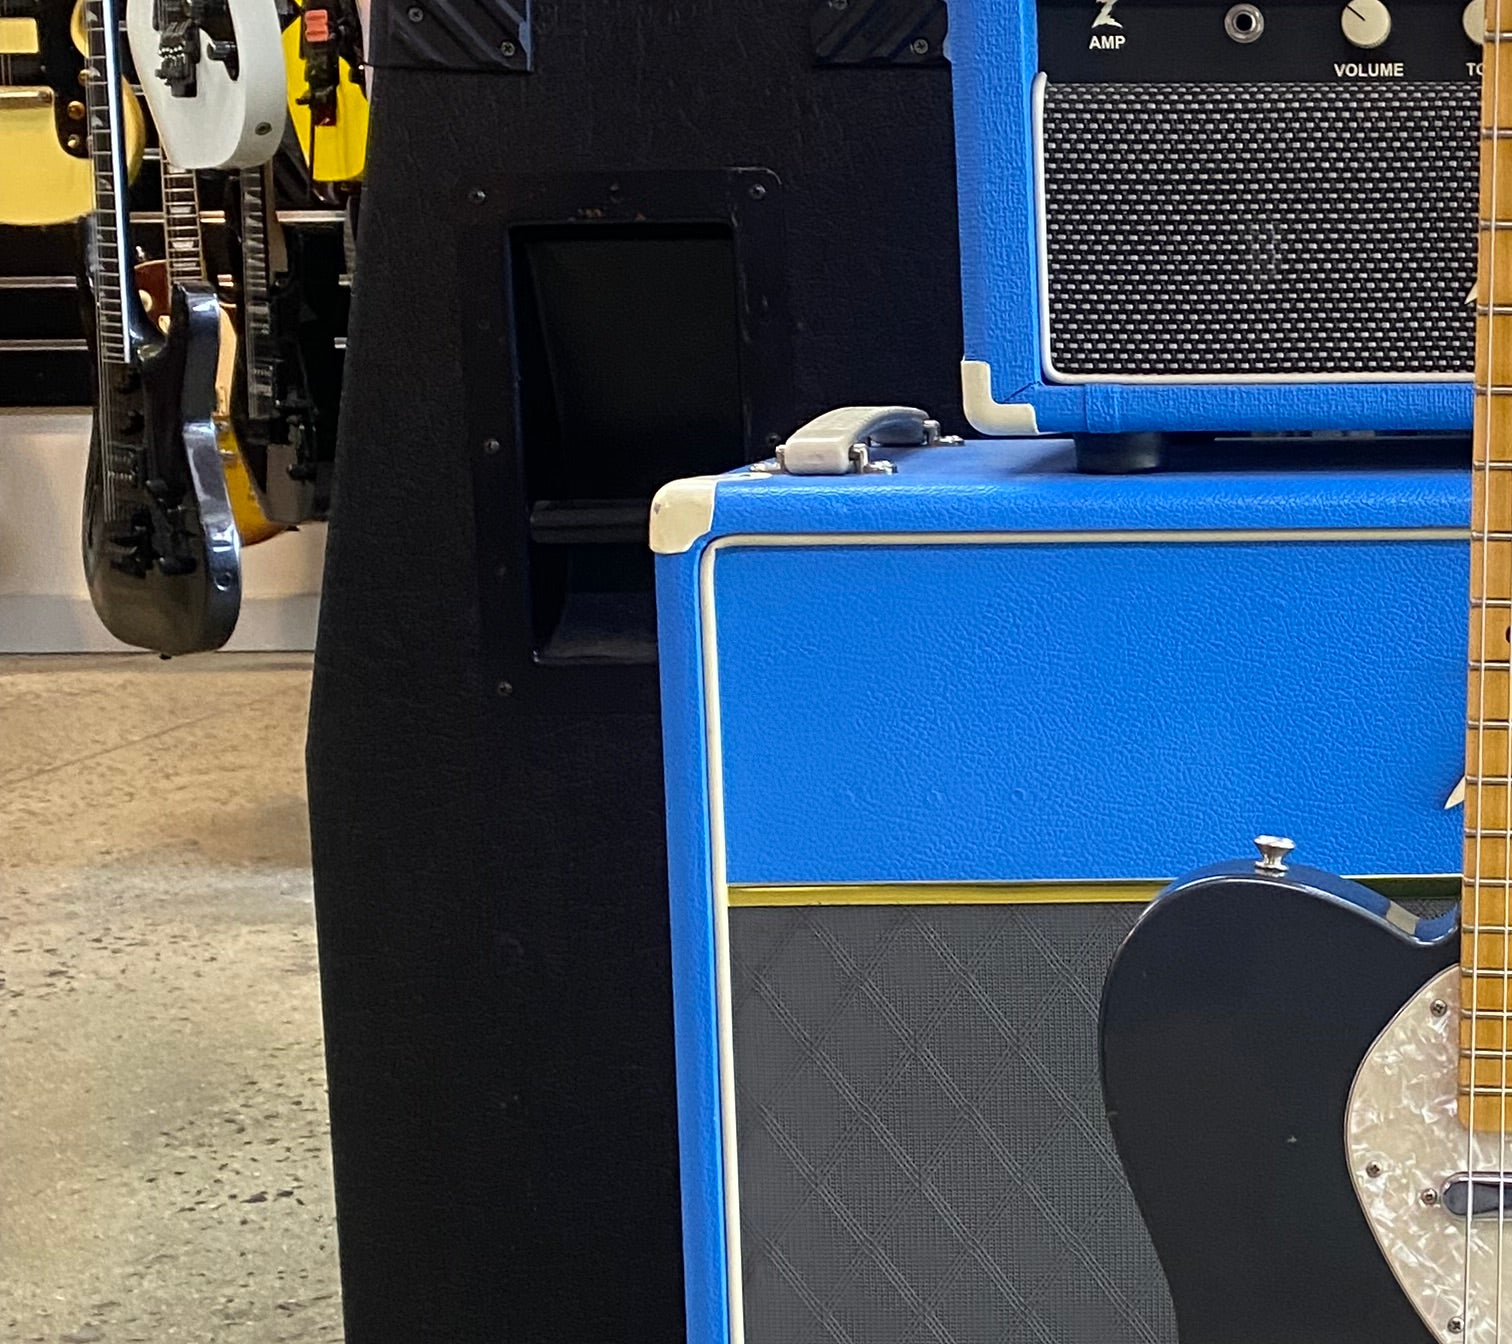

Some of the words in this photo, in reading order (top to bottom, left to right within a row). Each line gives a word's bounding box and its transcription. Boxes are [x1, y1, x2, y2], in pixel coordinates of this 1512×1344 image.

[1088, 35, 1126, 50] AMP
[1333, 62, 1404, 78] VOLUME
[1465, 63, 1485, 77] TO
